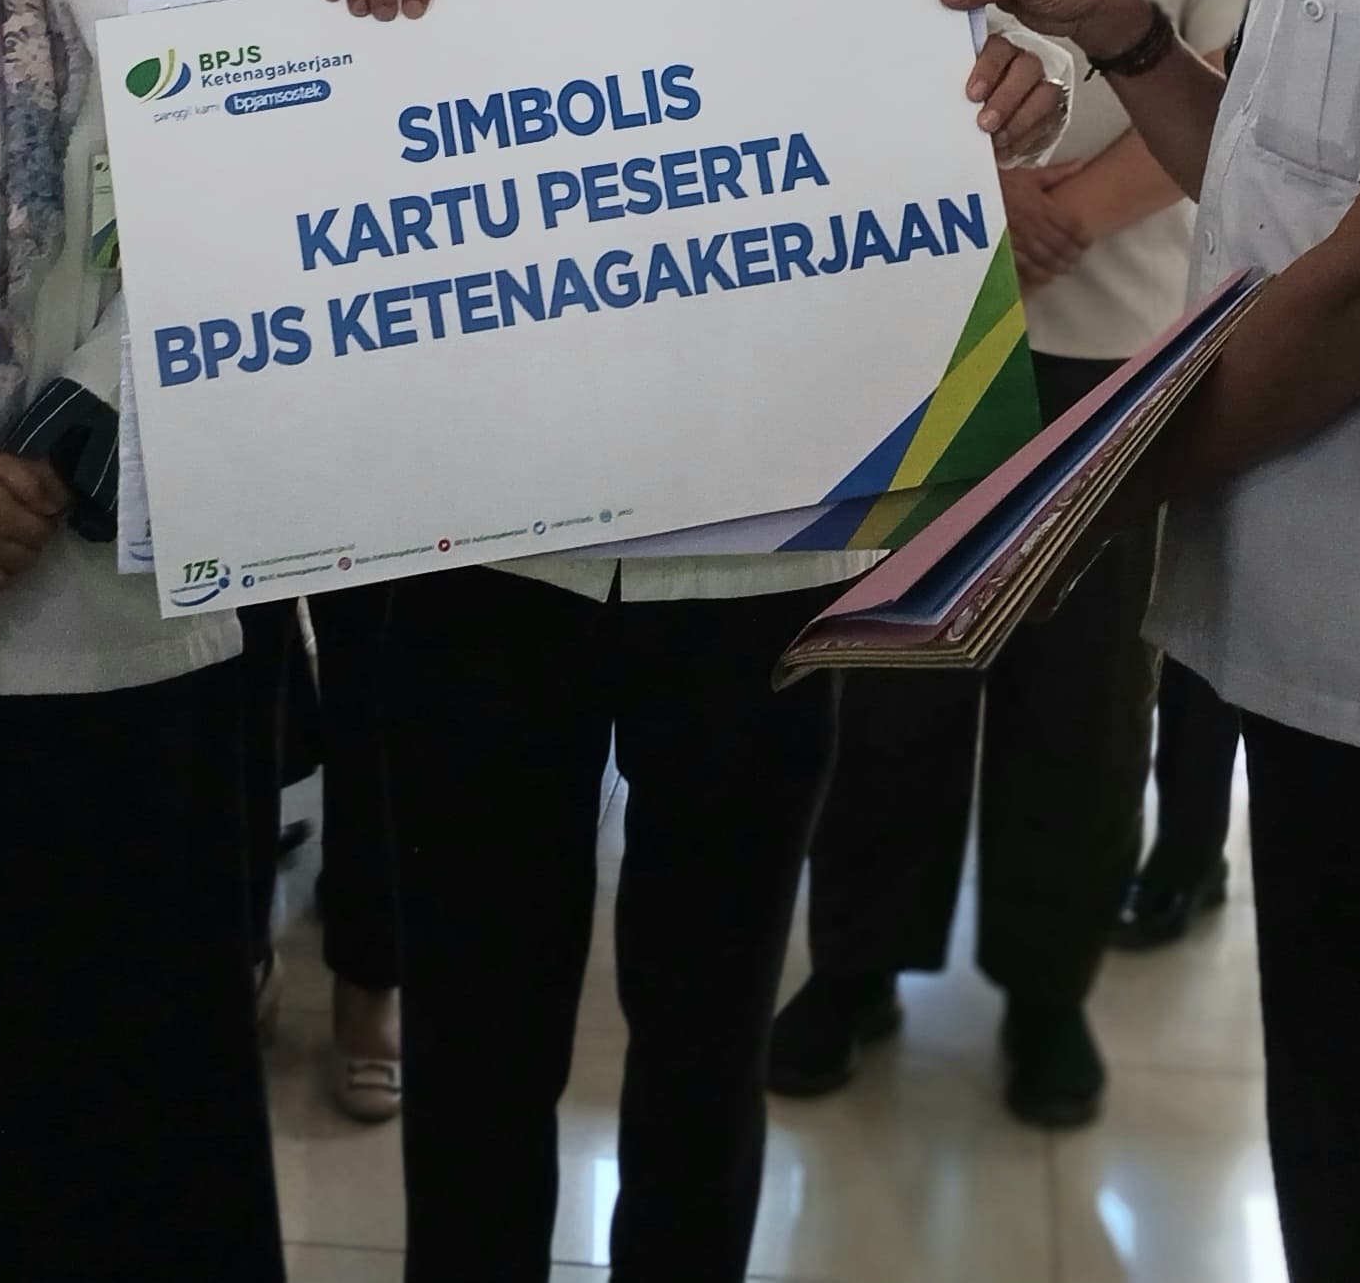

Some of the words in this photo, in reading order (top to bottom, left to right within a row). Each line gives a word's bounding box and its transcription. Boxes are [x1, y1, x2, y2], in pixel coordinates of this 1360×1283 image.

[199, 45, 262, 71] BPJS
[201, 53, 353, 88] Ketenagakerjaan
[233, 82, 323, 112] bpjamsostek
[397, 63, 702, 163] SIMBOLIS
[296, 178, 520, 271] KARTU
[537, 132, 830, 229] PESERTA
[154, 305, 313, 387] BPJS
[328, 194, 989, 357] KETENAGAKERJAAN
[182, 559, 219, 584] 175
